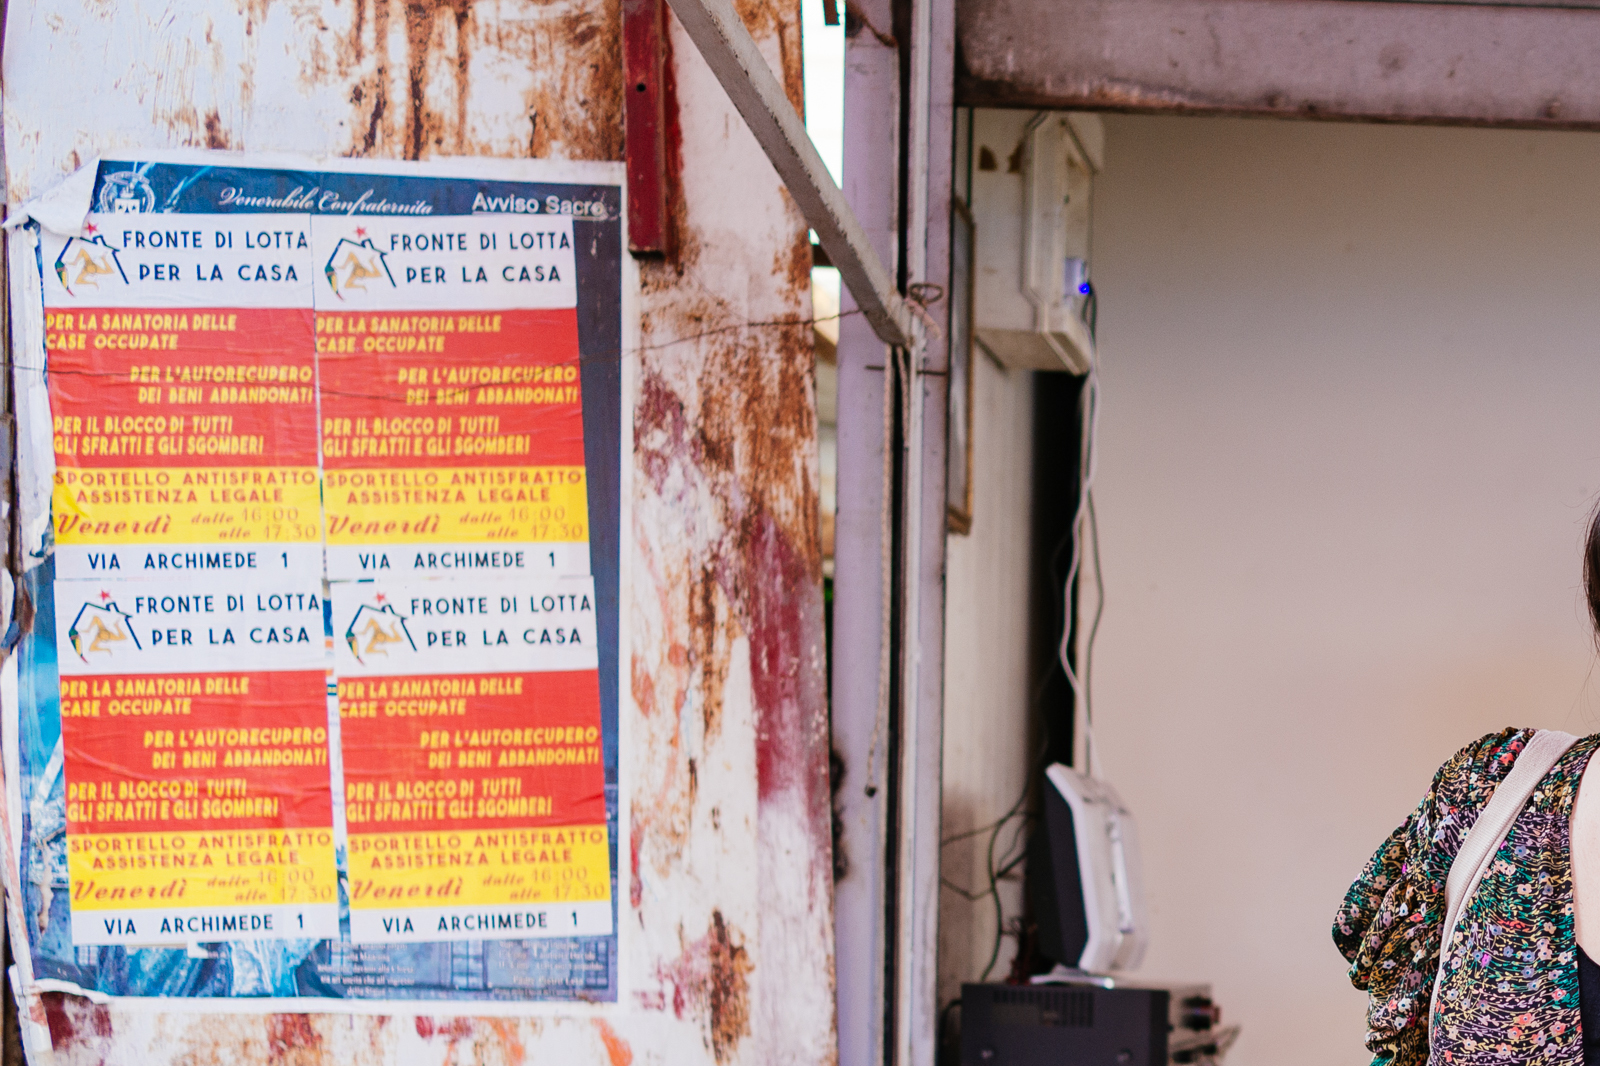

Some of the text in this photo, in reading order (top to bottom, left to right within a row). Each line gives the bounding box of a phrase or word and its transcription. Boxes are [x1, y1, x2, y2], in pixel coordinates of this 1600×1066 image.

[218, 185, 433, 214] Venerabile Confraternita
[472, 192, 605, 215] Avviso Sacro
[123, 231, 307, 248] FRONTE DI LOTTA
[391, 232, 570, 250] FRONTE DI LOTTA
[140, 264, 297, 281] PER LA CASA
[407, 264, 560, 283] PER LA CASA
[47, 314, 236, 330] PER LA SANATORIA DELLE
[317, 316, 501, 333] PER LA SANATORIA DELLE
[45, 334, 178, 349] CASE OCCUPATE
[315, 336, 444, 352] CASE OCCUPATE
[131, 366, 312, 382] PER L'AUTORECUPERO
[398, 367, 576, 384] PER L'AUTORECUPERO
[139, 387, 312, 403] DEI BENI ABBANDONATI
[477, 387, 577, 404] ABBANDONATI
[54, 416, 232, 434] PER IL BLOCCO DI TUTTI
[325, 416, 498, 435] PER IL BLOCCO DI TUTTI
[54, 436, 263, 455] GLI SFRATTI E GLI SGOMBERI
[323, 436, 529, 457] GLI SFRATTI E GLI SGOMBERI
[55, 470, 315, 486] SPORTELLO ANTISFRATTO
[327, 470, 581, 487] SPORTELLO ANTISFRATTO
[77, 488, 283, 503] ASSISTENZA LEGALE
[347, 488, 548, 504] ASSISTENZA LEGALE
[88, 553, 287, 569] VIA ARCHIMEDE 1
[359, 552, 554, 569] VIA ARCHIMEDE 1
[136, 594, 319, 613] FRONTE DI LOTTA
[411, 595, 590, 614] FRONTE DI LOTTA
[152, 627, 309, 645] PER LA CASA
[428, 628, 582, 646] PER LA CASA
[60, 677, 249, 697] PER LA SANATORIA DELLE
[338, 678, 522, 699] PER LA SANATORIA DELLE
[61, 698, 191, 717] CASE OCCUPATE
[339, 699, 465, 718] CASE OCCUPATE
[145, 727, 326, 747] PER L'AUTORECUPERO
[421, 727, 598, 747] PER L'AUTORECUPERO
[153, 749, 326, 768] DEI BENI ABBANDONATI
[429, 747, 598, 768] DEI BENI ABBANDONATI
[69, 778, 246, 800] PER IL BLOCCO DI TUTTI
[348, 778, 521, 800] PER IL BLOCCO DI TUTTI
[67, 798, 277, 822] GLI SFRATTI E GLI SGOMBERI
[347, 798, 551, 822] GLI SFRATTI E GLI SGOMBERI
[72, 833, 330, 852] SPORTELLO ANTISFRATTO
[350, 830, 603, 852] SPORTELLO ANTISFRATTO
[93, 851, 296, 869] ASSISTENZA LEGALE
[371, 849, 570, 868] ASSISTENZA LEGALE
[104, 914, 302, 934] VIA ARCHIMEDE 1
[383, 912, 576, 932] VIA ARCHIMEDE 1
